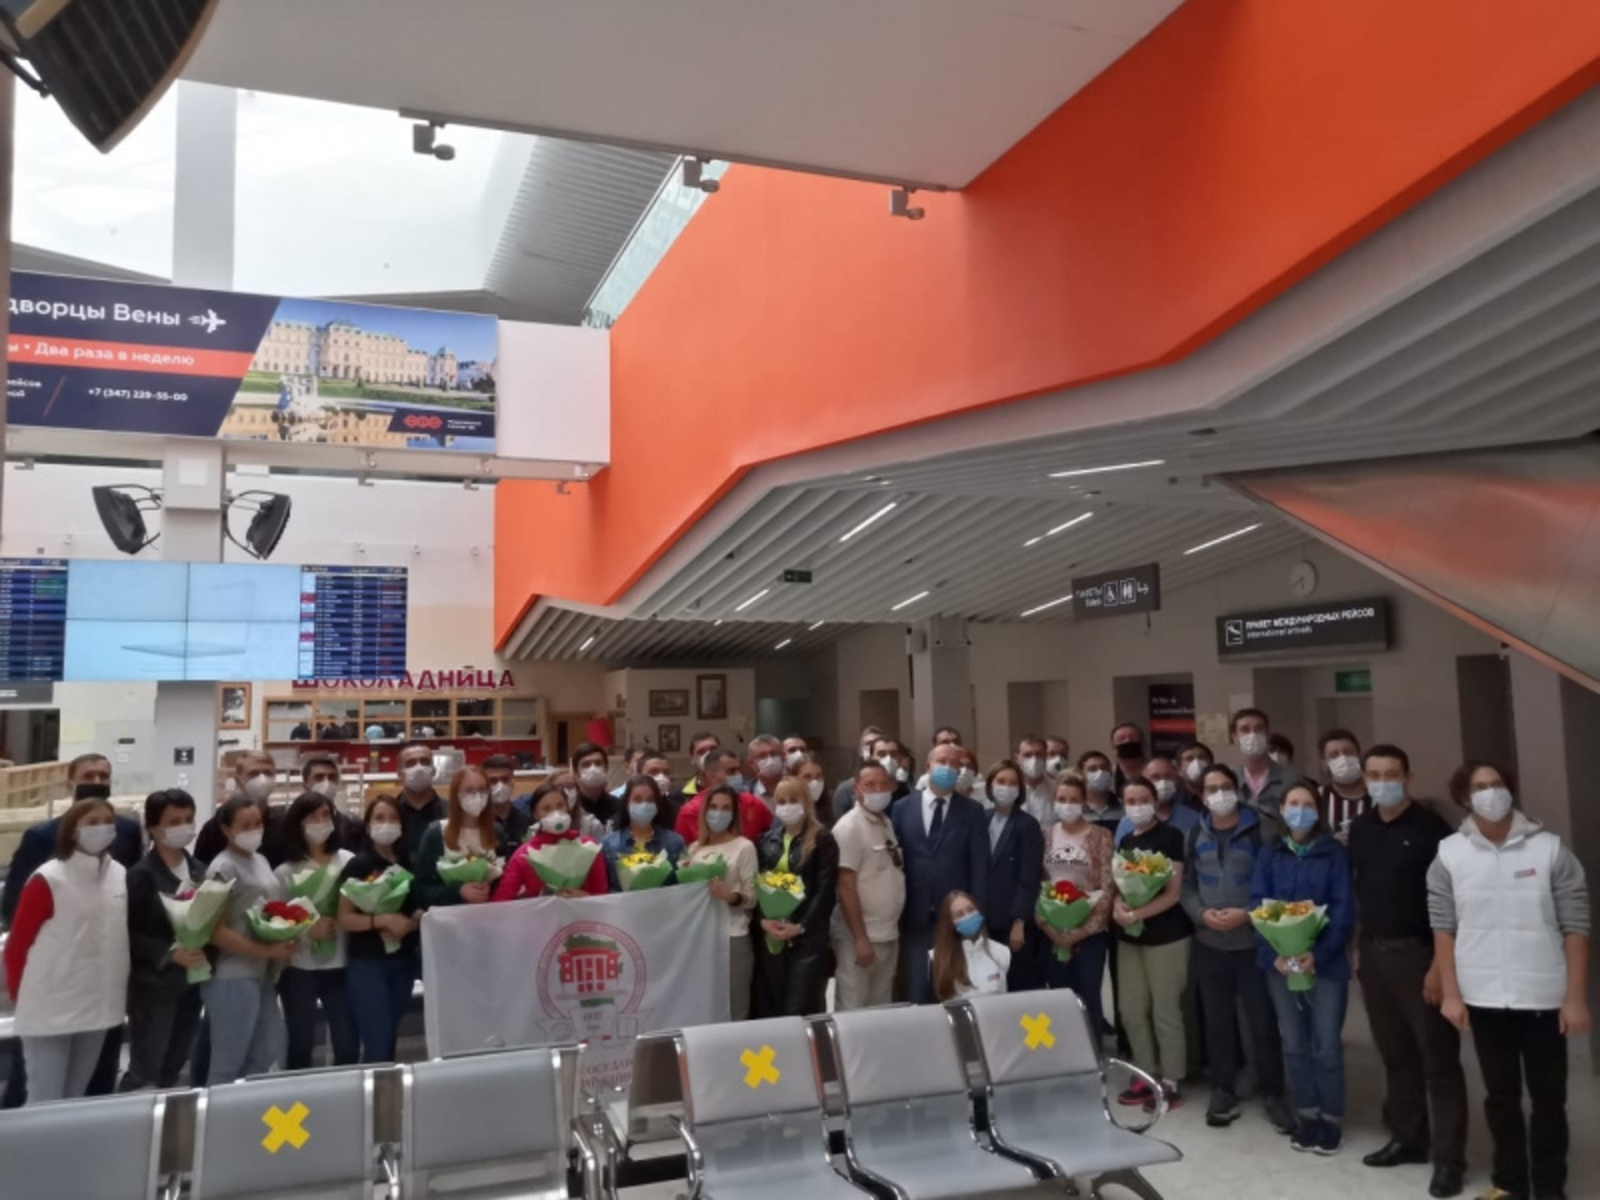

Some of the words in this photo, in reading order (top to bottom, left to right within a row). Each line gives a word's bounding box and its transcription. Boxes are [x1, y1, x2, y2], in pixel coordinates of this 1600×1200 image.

[8, 298, 105, 321] дворцы
[113, 303, 180, 326] Вены
[35, 342, 69, 357] Два
[73, 344, 114, 360] раза
[117, 350, 127, 360] в
[132, 350, 195, 366] неделю
[88, 387, 101, 397] +7
[103, 388, 131, 399] (347)
